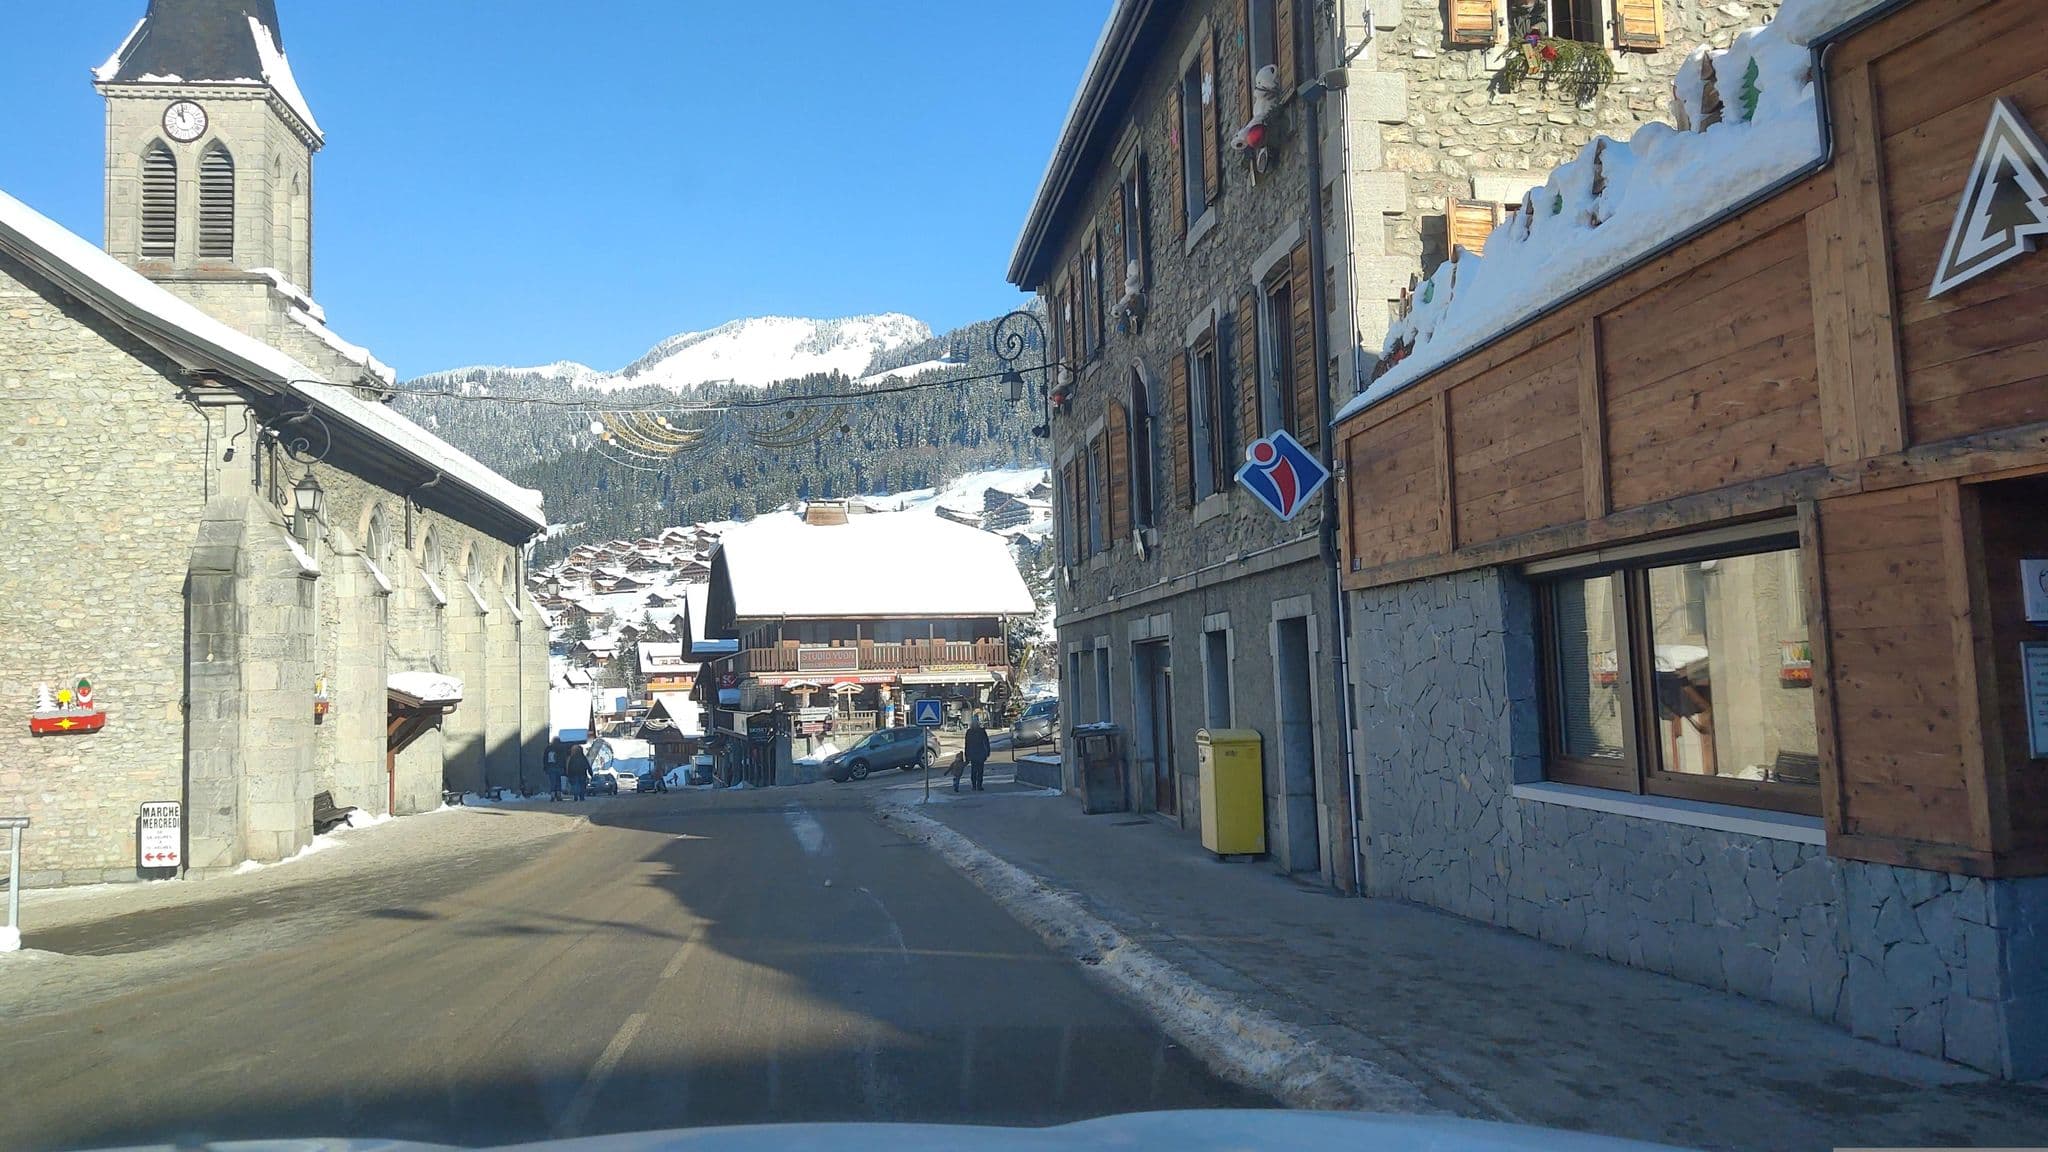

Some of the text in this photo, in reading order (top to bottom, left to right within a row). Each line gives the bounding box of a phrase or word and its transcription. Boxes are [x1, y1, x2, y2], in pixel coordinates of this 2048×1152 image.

[801, 651, 830, 661] STUDIO
[143, 807, 179, 818] MARCHE
[143, 818, 179, 828] MERCREDI
